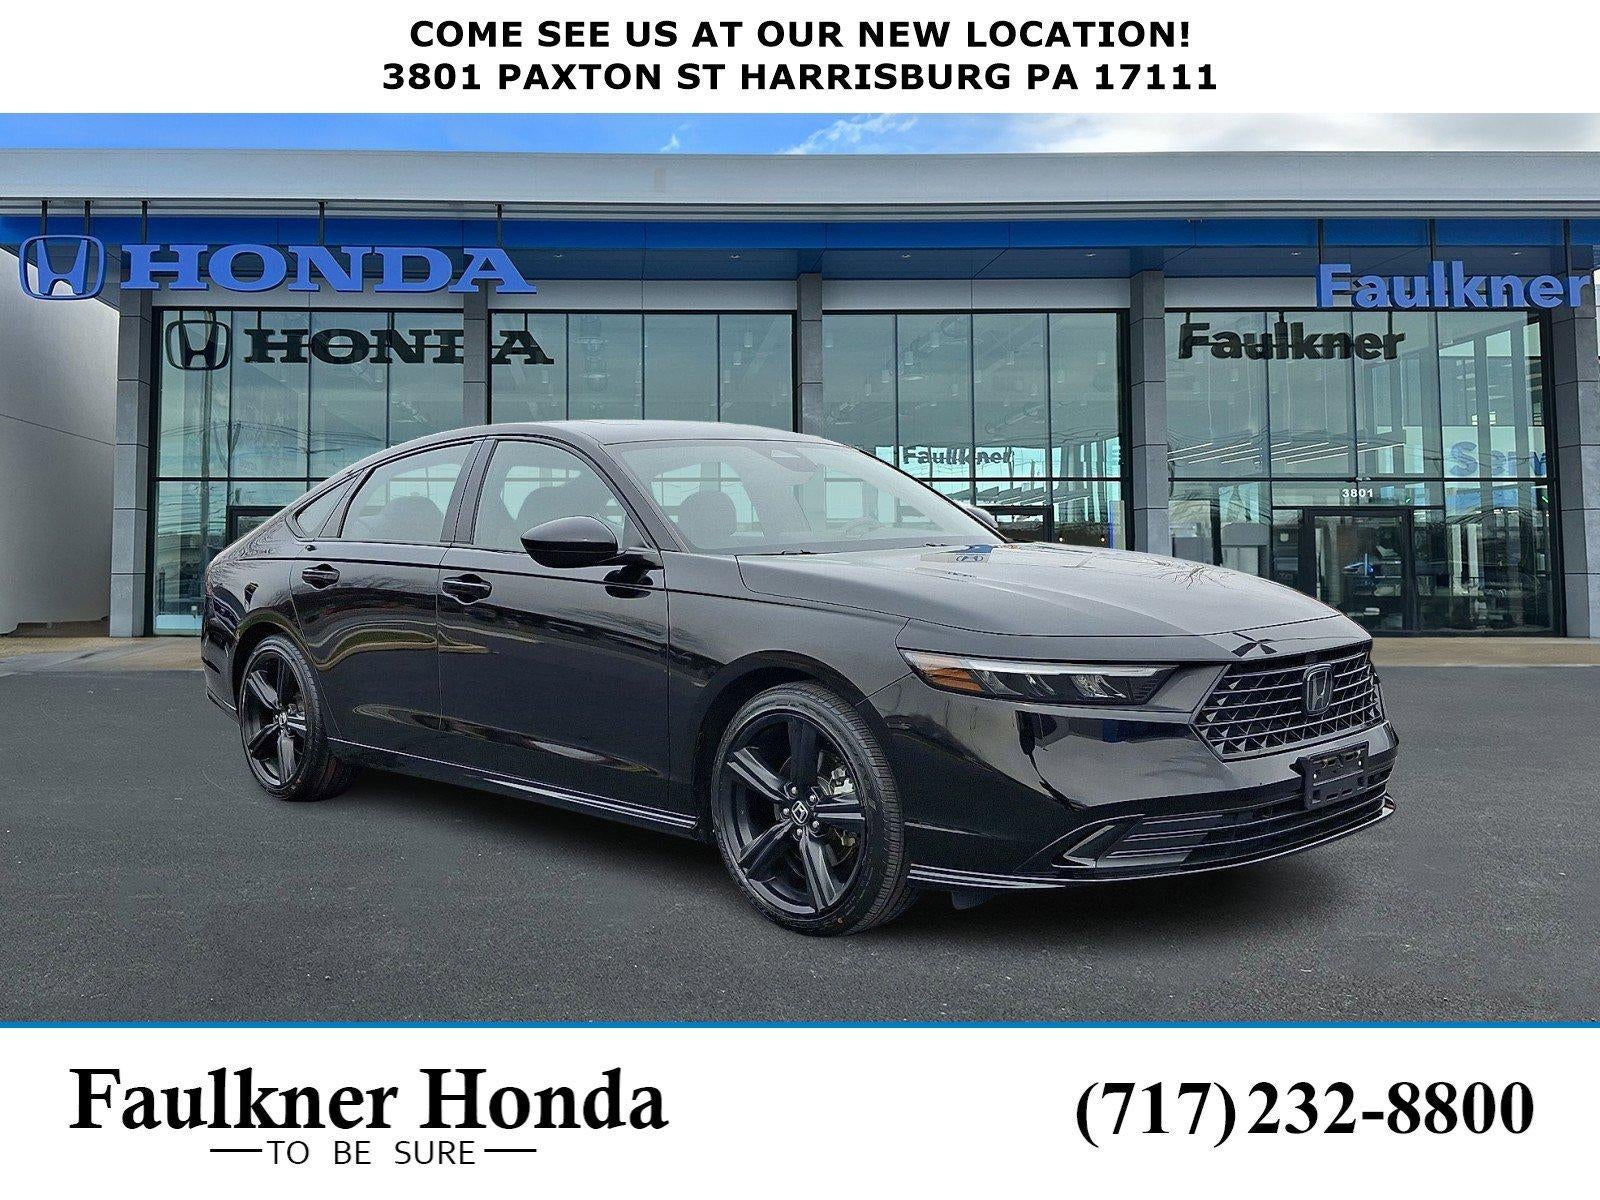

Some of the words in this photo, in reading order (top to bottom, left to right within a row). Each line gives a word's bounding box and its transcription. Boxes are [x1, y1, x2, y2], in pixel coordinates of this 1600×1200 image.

[121, 243, 537, 294] HONDA
[1316, 261, 1590, 308] Faulkner
[1178, 322, 1404, 360] Faulkner
[1342, 488, 1374, 498] 3801
